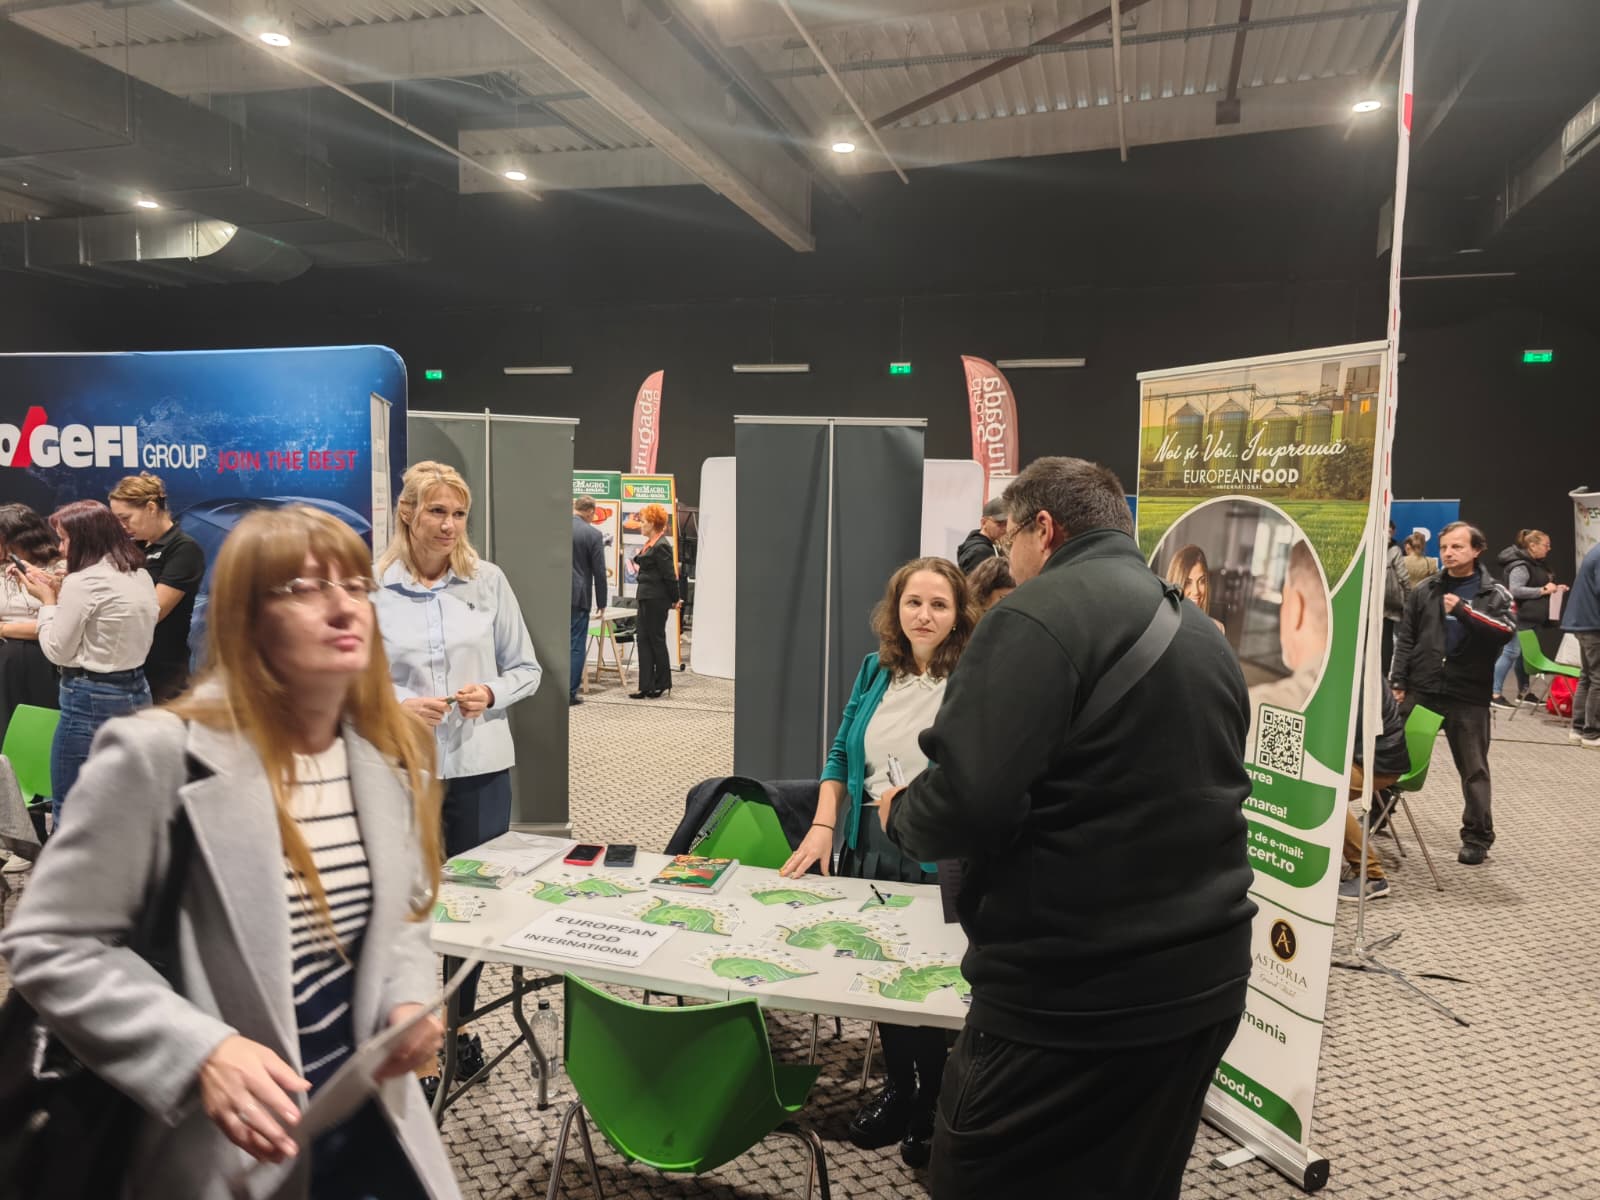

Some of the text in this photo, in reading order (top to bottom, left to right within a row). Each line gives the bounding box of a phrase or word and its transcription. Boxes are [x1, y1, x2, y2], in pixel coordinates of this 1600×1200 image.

[142, 444, 207, 469] GROUP
[1153, 431, 1181, 462] Noi
[217, 450, 358, 474] JOIN THE BEST
[1184, 468, 1299, 484] EUROPEANFOOD
[1254, 832, 1268, 844] de
[1269, 839, 1304, 859] e-mail:
[1247, 845, 1295, 873] cert.ro
[555, 916, 657, 937] EUROPEAN
[566, 929, 621, 943] FOOD
[524, 933, 639, 957] INTERNATIONAL
[1255, 953, 1307, 988] ASTORIA
